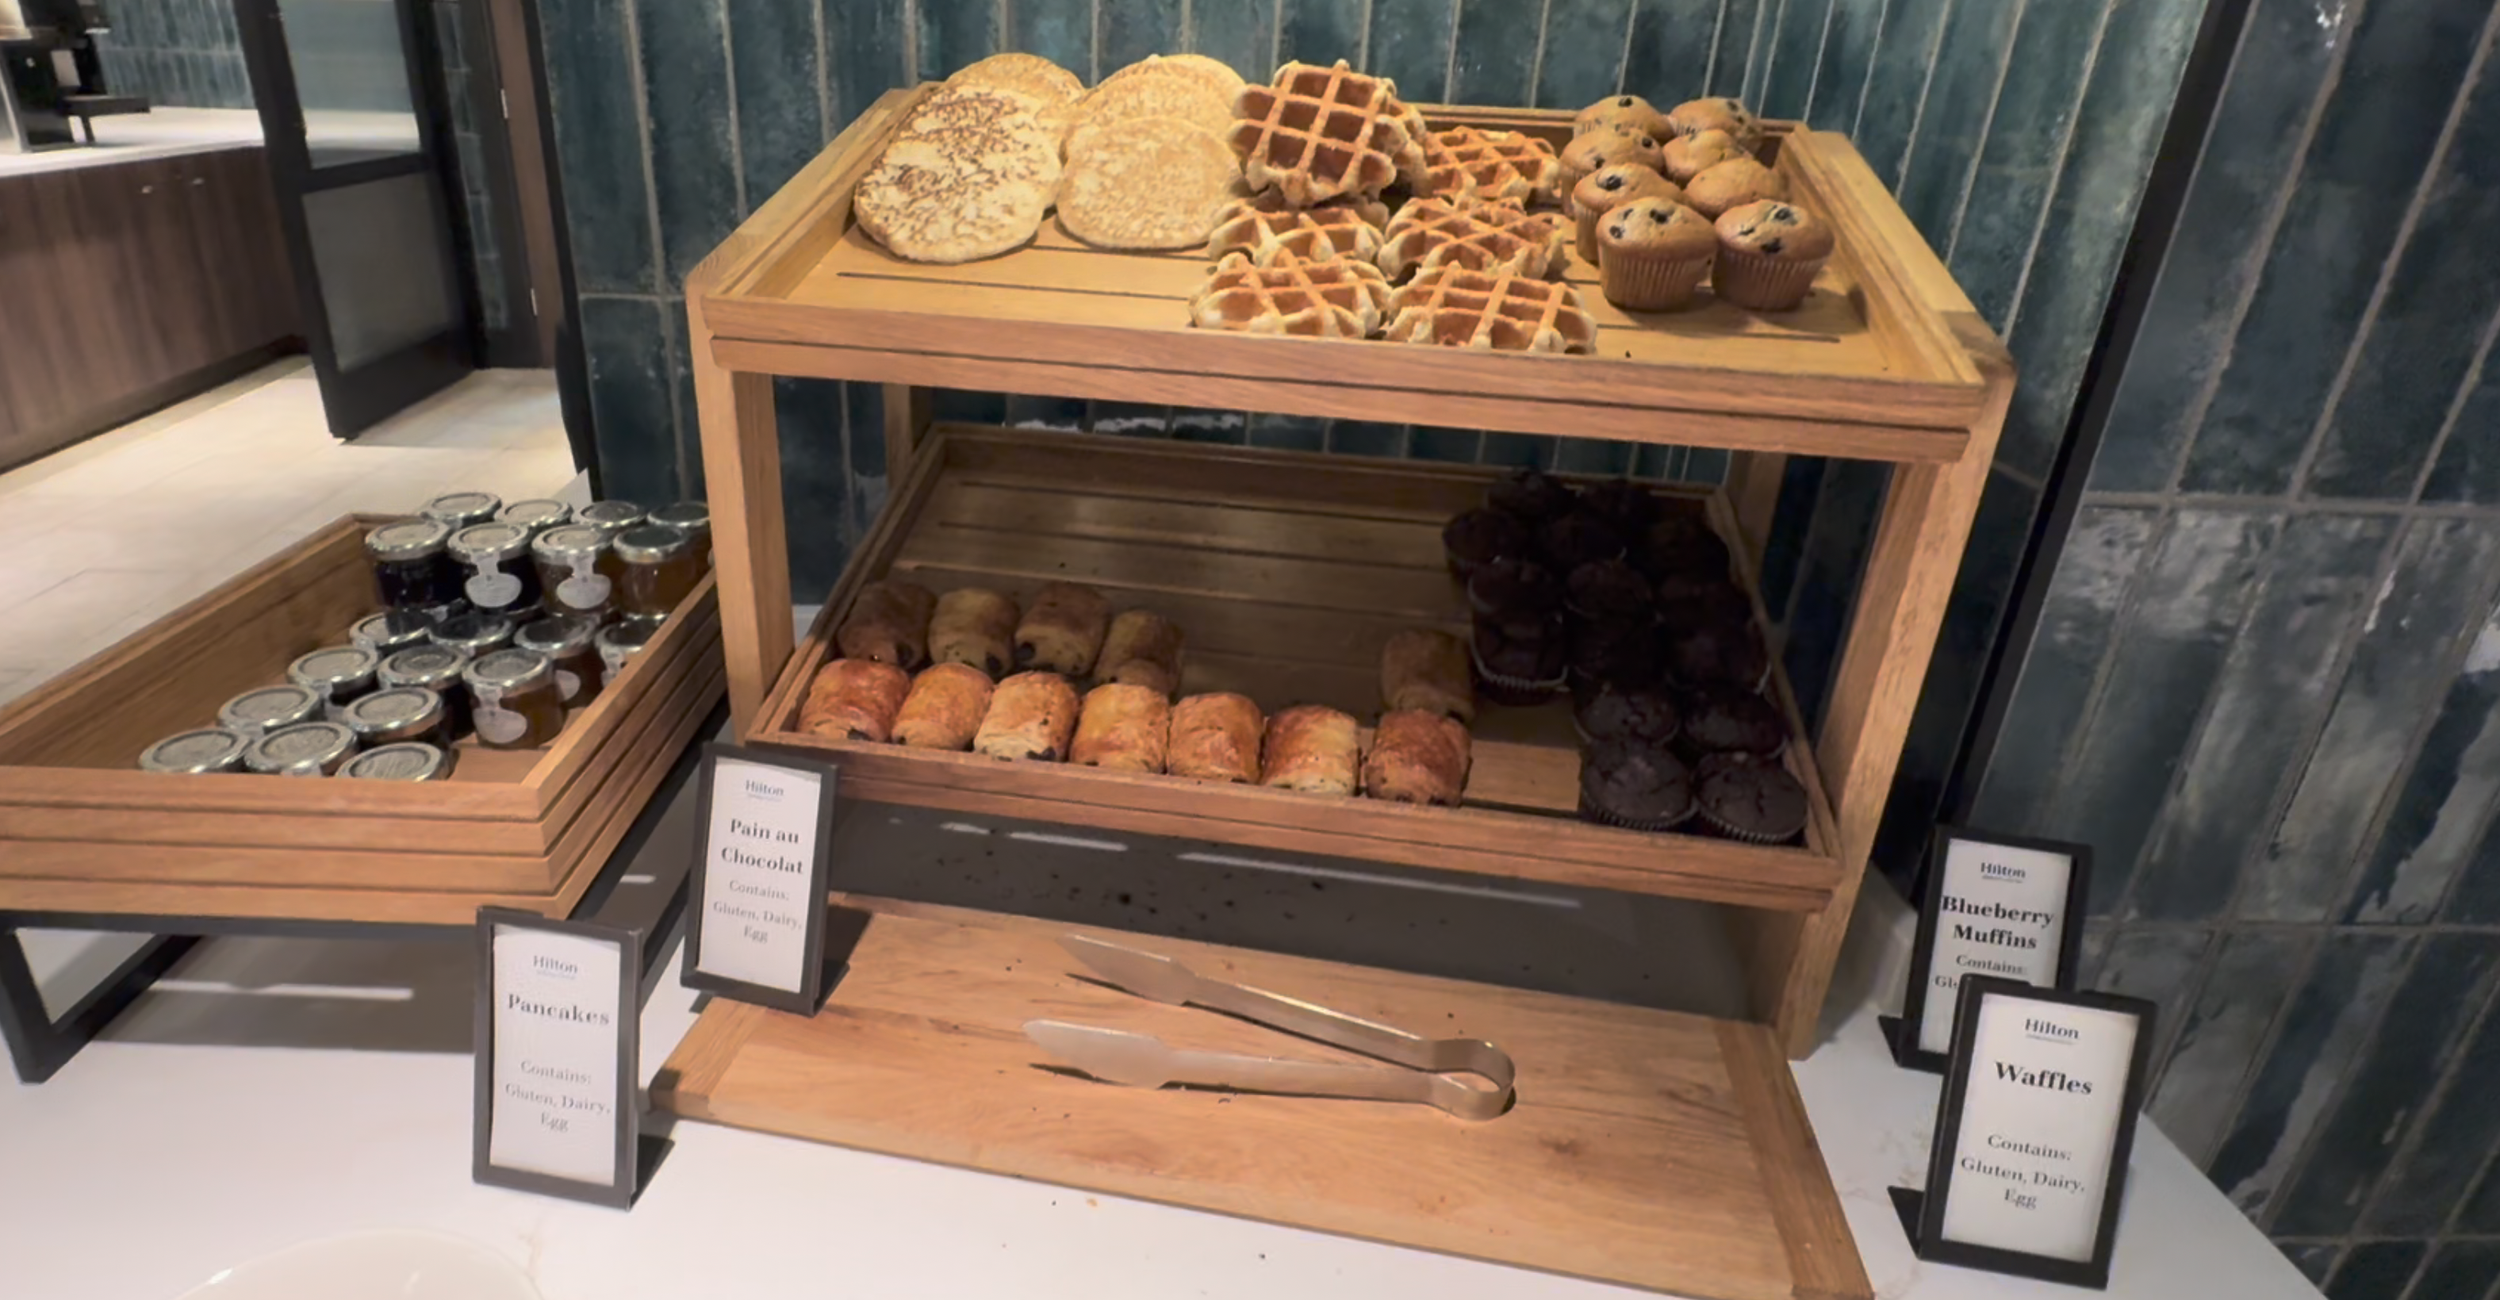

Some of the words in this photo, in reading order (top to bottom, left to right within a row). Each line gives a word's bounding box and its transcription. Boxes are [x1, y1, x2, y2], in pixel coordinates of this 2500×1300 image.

[745, 780, 784, 796] Hilton
[730, 819, 770, 840] Pain
[776, 829, 799, 844] au
[721, 847, 803, 874] Chocolat
[1981, 862, 2026, 878] Hilton
[729, 880, 789, 901] Contains:
[713, 901, 759, 921] Gluten,
[763, 911, 802, 929] Dairy,
[1941, 895, 2053, 928] Blueberry
[743, 925, 768, 944] Egg
[1953, 924, 2037, 949] Muffins
[533, 955, 578, 974] Hilton
[507, 993, 610, 1025] Pancakes
[2025, 1018, 2080, 1039] Hilton
[521, 1060, 591, 1085] Contains:
[1995, 1062, 2092, 1095] Waffles
[505, 1083, 557, 1106] Gluten,
[562, 1095, 611, 1114] Dairy,
[540, 1112, 569, 1132] Egg
[1988, 1134, 2071, 1161] Contains:
[1961, 1157, 2027, 1184] Gluten,
[2034, 1172, 2085, 1193] Dairy,
[2004, 1189, 2037, 1210] Egg
